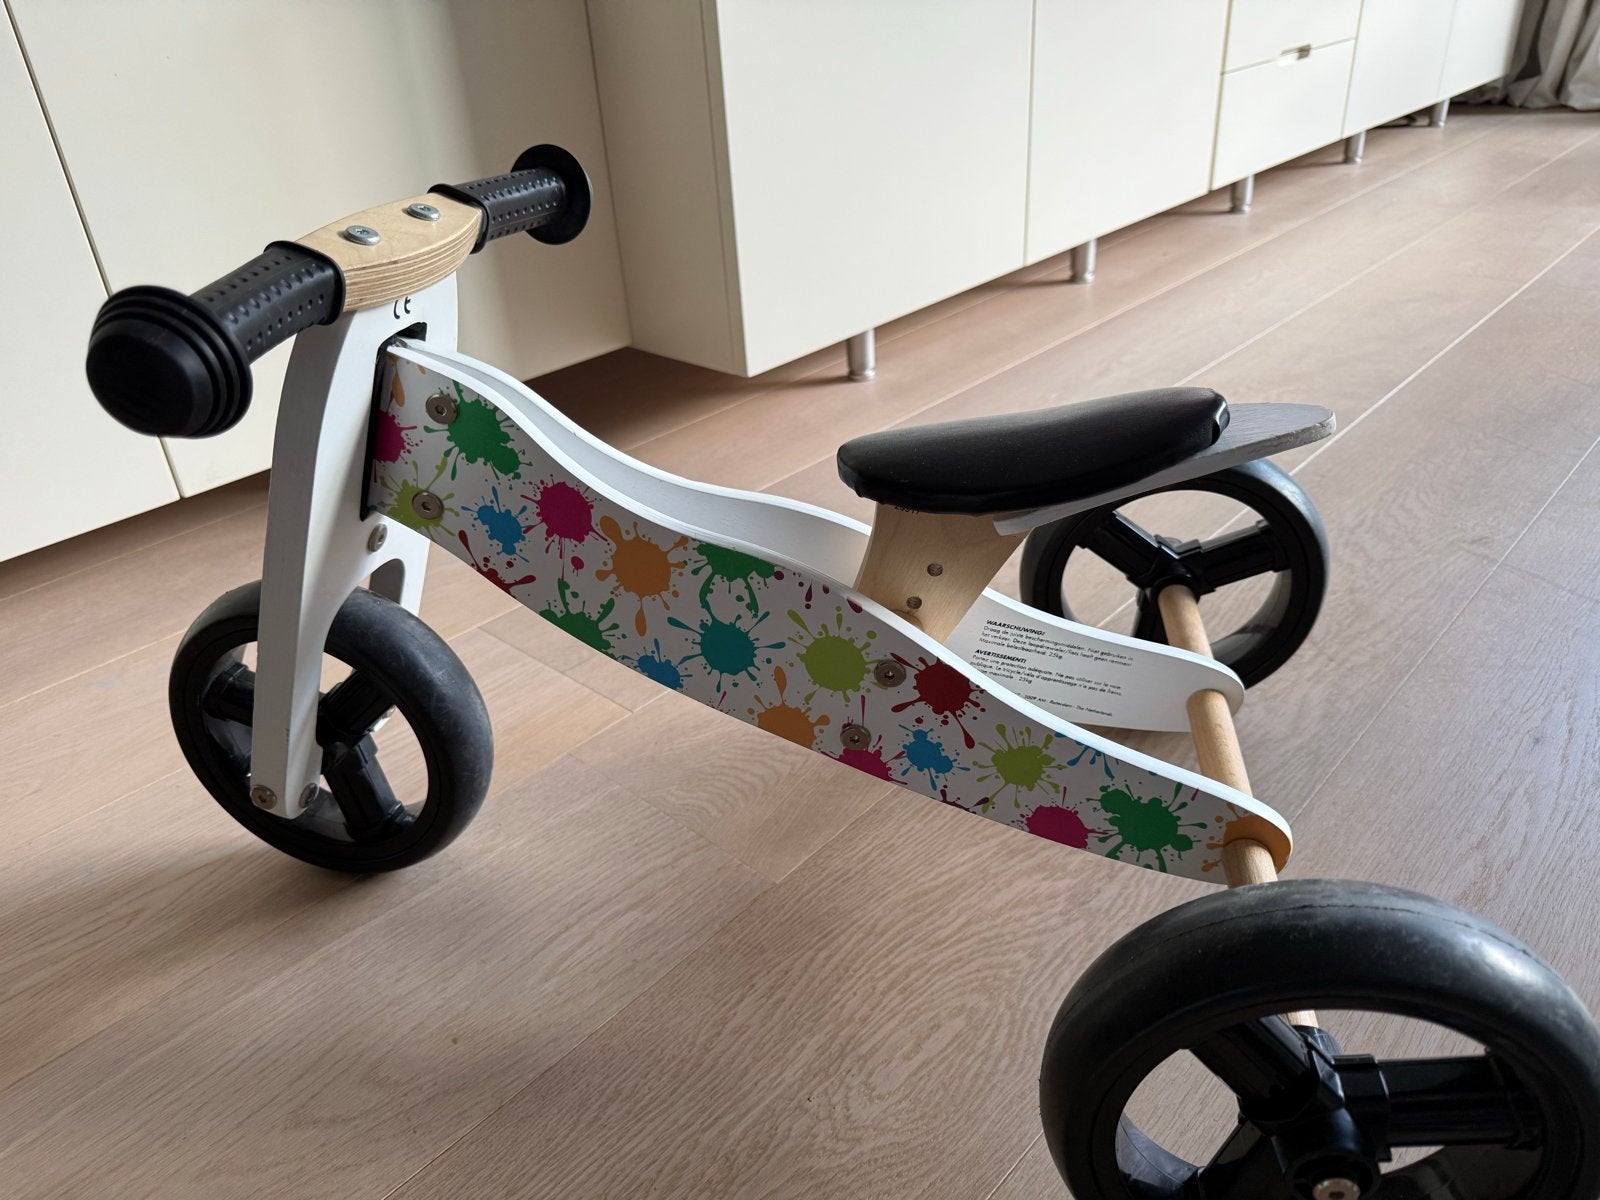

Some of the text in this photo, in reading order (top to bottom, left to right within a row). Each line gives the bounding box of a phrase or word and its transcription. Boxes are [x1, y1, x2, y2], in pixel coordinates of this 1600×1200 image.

[986, 619, 1046, 636] WAARSCHUWING!
[979, 637, 1005, 646] Maximale
[1048, 651, 1063, 660] 25kg
[983, 625, 1001, 634] Draag
[1100, 651, 1127, 660] gebruiken
[974, 649, 1027, 664] AVERTISSEMENT!
[1000, 661, 1027, 670] protection
